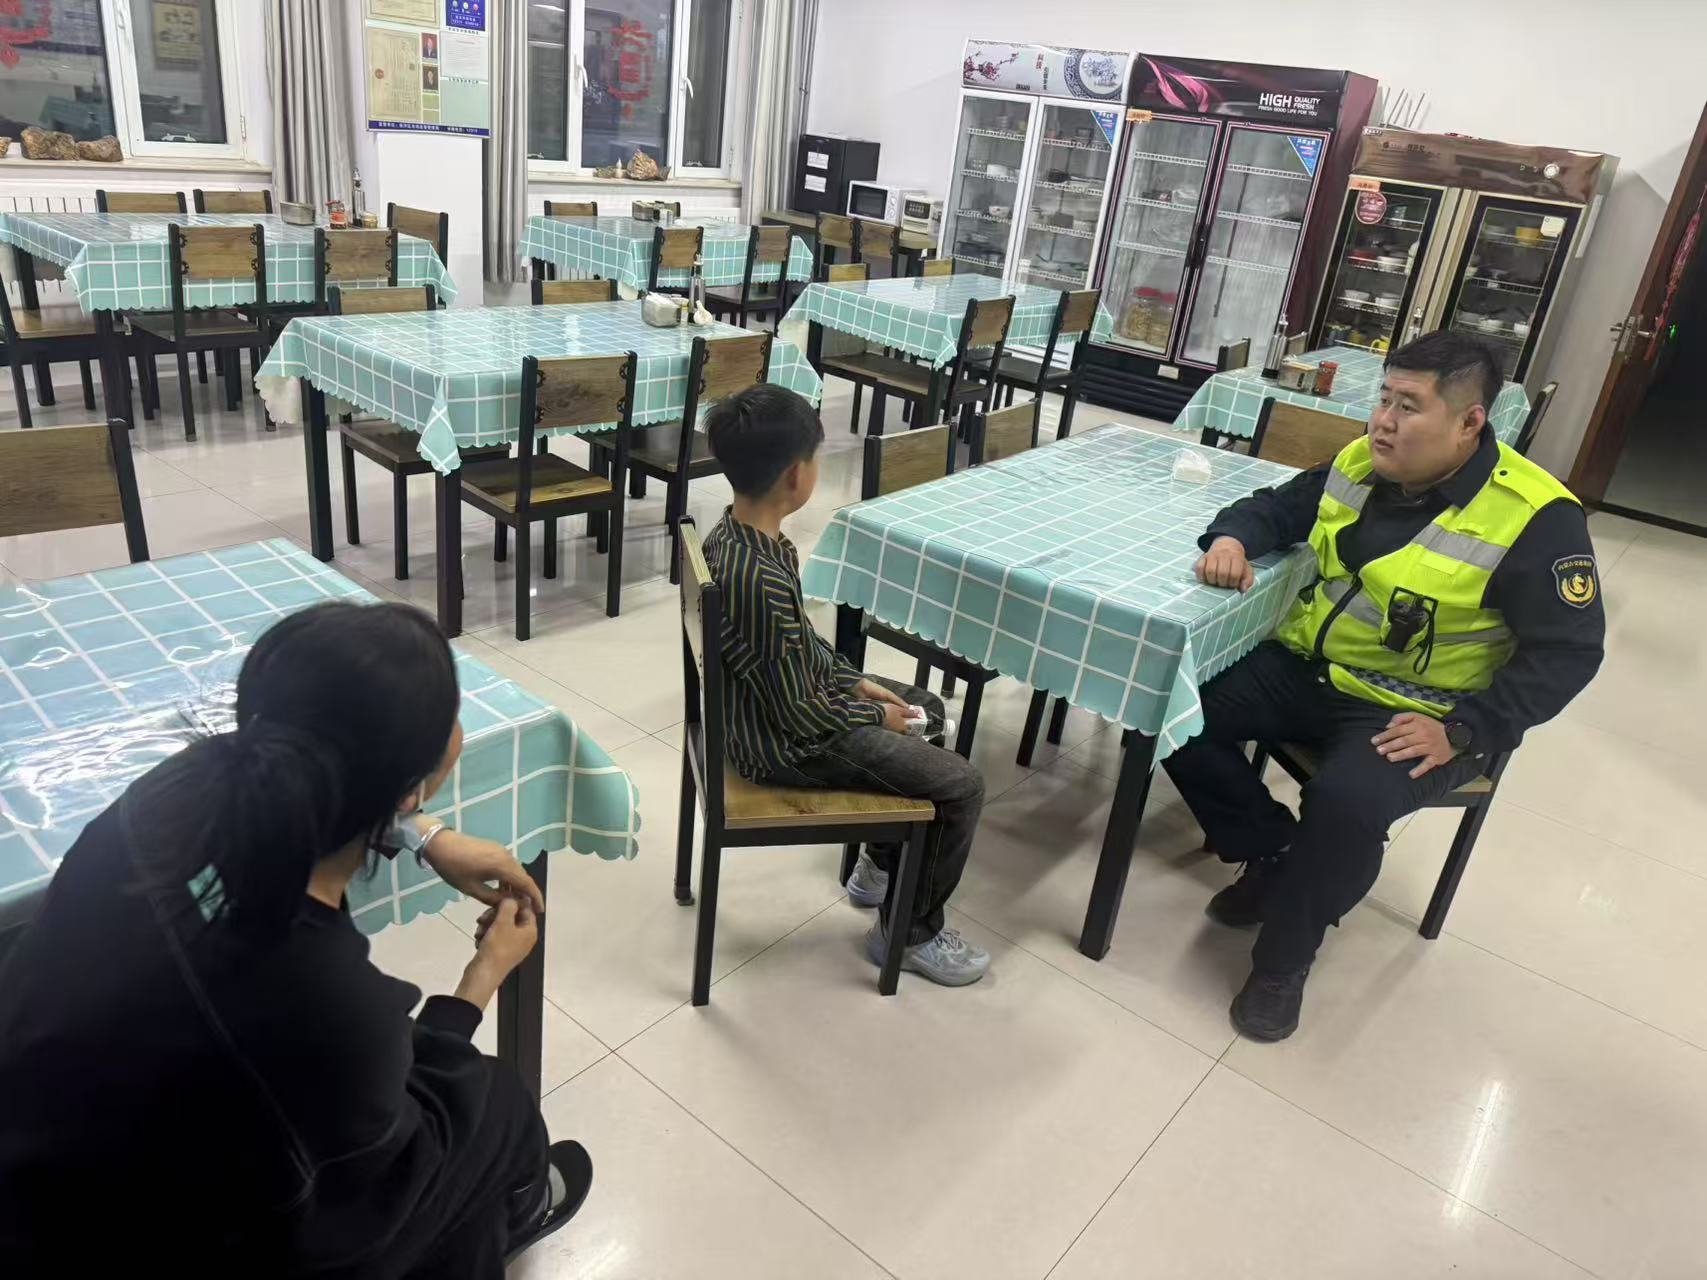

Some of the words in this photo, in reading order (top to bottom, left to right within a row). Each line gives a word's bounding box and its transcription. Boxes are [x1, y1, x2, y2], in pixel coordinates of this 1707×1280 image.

[1260, 93, 1292, 107] HIGH
[1294, 96, 1320, 104] QUALITY
[1293, 102, 1315, 110] FRESH
